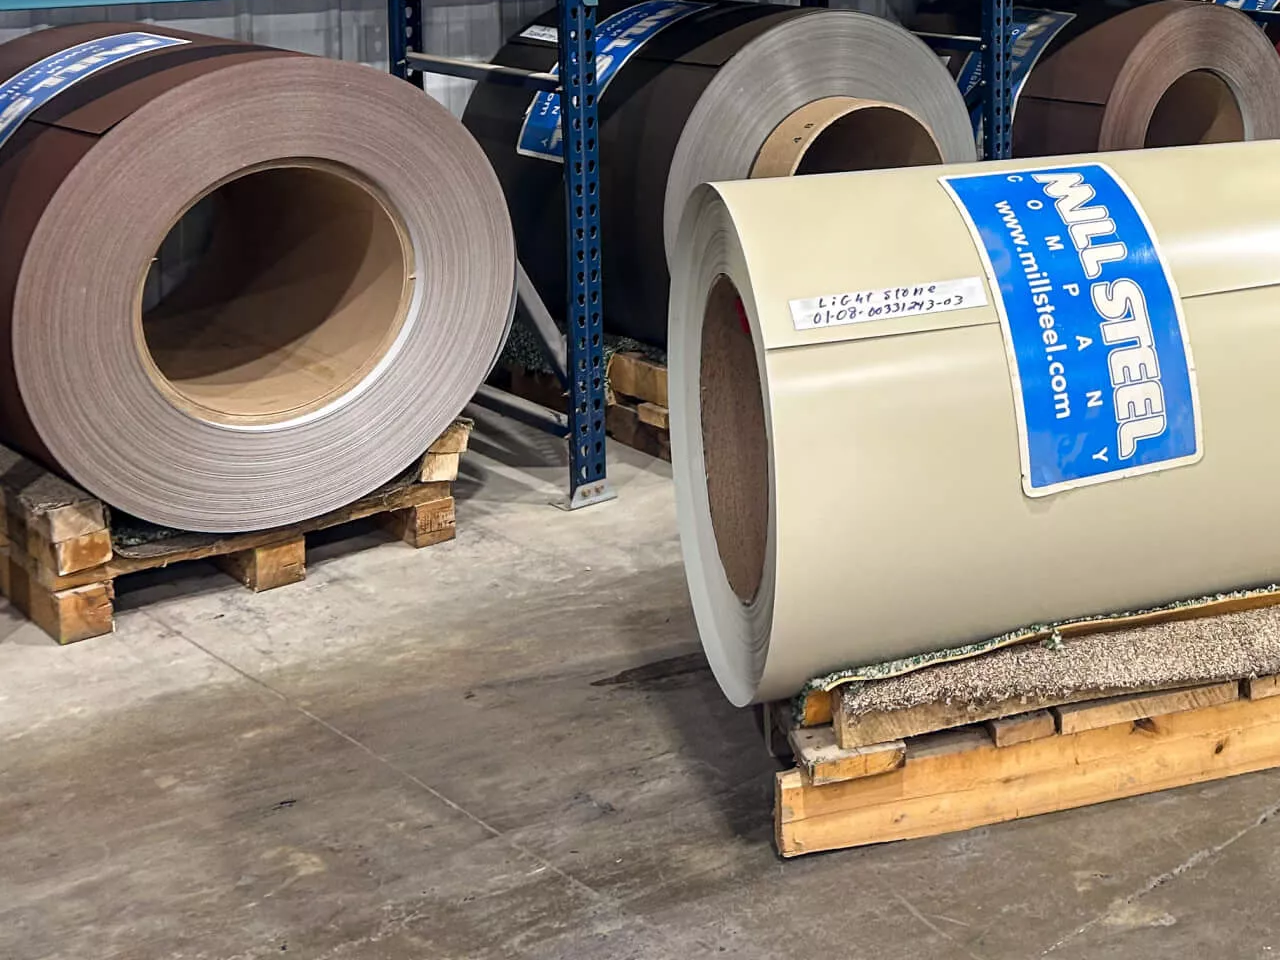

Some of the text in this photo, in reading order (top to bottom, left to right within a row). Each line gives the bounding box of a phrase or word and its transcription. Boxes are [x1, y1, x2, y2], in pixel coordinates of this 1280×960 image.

[993, 199, 1072, 420] www.millsteel.com
[1031, 172, 1168, 460] MILL STEEL
